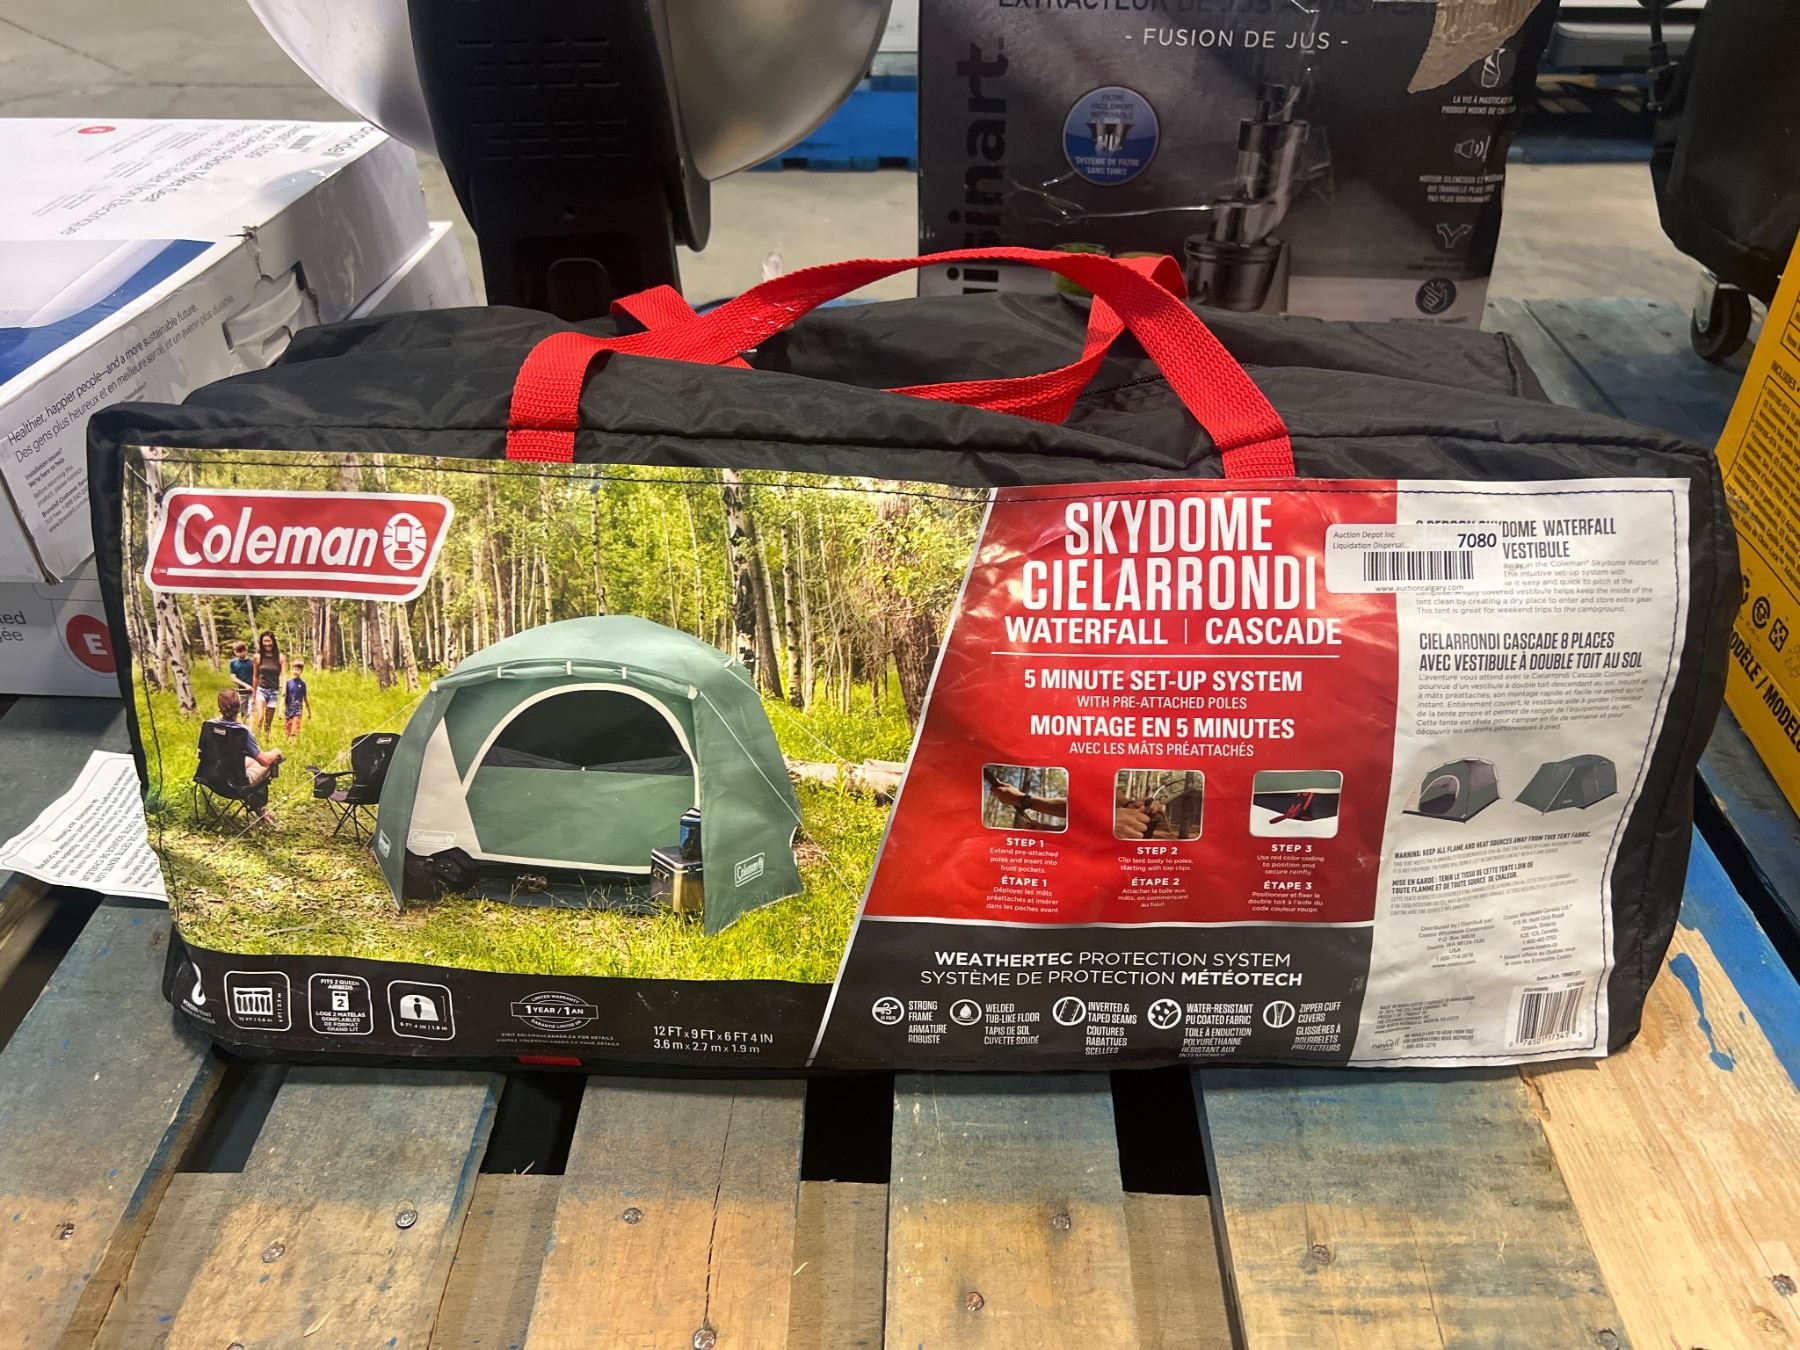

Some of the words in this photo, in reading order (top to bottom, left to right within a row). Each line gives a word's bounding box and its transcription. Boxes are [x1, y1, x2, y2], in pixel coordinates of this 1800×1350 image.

[1143, 28, 1234, 48] FUSION
[1244, 30, 1276, 48] DE
[1286, 32, 1330, 50] JUS
[8, 414, 47, 446] Healthier,
[45, 391, 76, 418] happier
[126, 343, 144, 360] more
[143, 317, 178, 347] sustainable
[177, 304, 198, 322] future.
[1770, 358, 1798, 392] INCLUDES
[16, 446, 33, 462] Des
[33, 430, 54, 452] gens
[52, 417, 70, 438] plus
[68, 395, 100, 422] heureux
[100, 388, 108, 400] et
[108, 382, 118, 394] en
[117, 360, 147, 386] meilleure
[165, 338, 174, 350] et
[172, 333, 182, 344] un
[182, 320, 200, 338] avenir
[200, 310, 213, 328] plus
[1064, 497, 1273, 555] SKYDOME
[1543, 518, 1616, 536] WATERFALL
[174, 504, 378, 567] Coleman
[1363, 532, 1383, 540] Depot
[1457, 533, 1497, 548] 7080
[1333, 542, 1371, 550] Liquidation
[1503, 541, 1570, 559] VESTIBULE
[1022, 555, 1316, 611] CIELARRONDI
[1375, 584, 1464, 592] www.auctioncalgary.com
[1005, 617, 1168, 645] WATERFALL
[1205, 618, 1342, 645] CASCADE
[82, 633, 108, 655] E
[1419, 633, 1500, 650] CIELARRONDI
[1503, 633, 1558, 650] CASCADE
[1561, 633, 1568, 648] 8
[1571, 632, 1614, 648] PLACES
[1419, 654, 1451, 671] AVEC
[1454, 653, 1516, 671] VESTIBULE
[1519, 651, 1528, 670] À
[1529, 652, 1573, 670] DOUBLE
[1576, 652, 1601, 669] TOIT
[1603, 652, 1618, 669] AU
[1621, 652, 1642, 668] SOL
[1730, 632, 1761, 682] ODÈLE
[1024, 669, 1036, 689] 5
[1041, 670, 1124, 690] MINUTE
[1130, 670, 1207, 691] SET-UP
[1212, 671, 1302, 692] SYSTEM
[1077, 696, 1110, 708] WITH
[1112, 696, 1204, 709] PRE-ATTACHED
[1208, 697, 1247, 710] POLES
[1030, 715, 1136, 738] MONTAGE
[1142, 717, 1170, 738] EN
[1177, 718, 1188, 738] 5
[1194, 718, 1295, 739] MINUTES
[1069, 742, 1101, 754] AVEC
[1103, 742, 1125, 755] LES
[1128, 739, 1164, 756] MÂTS
[1166, 741, 1254, 757] PRÉATTACHÉS
[1006, 838, 1036, 847] STEP
[1040, 839, 1044, 847] 1
[1272, 844, 1301, 852] STEP
[1015, 849, 1058, 857] pre-attached
[1137, 847, 1167, 855] STEP
[1171, 847, 1178, 855] 2
[1001, 875, 1038, 887] ÉTAPE
[1042, 879, 1047, 887] 1
[1132, 877, 1168, 886] ÉTAPE
[1264, 881, 1301, 889] ÉTAPE
[934, 952, 1073, 967] WEATHERTEC
[1078, 952, 1206, 966] PROTECTION
[1212, 952, 1290, 967] SYSTEM
[920, 969, 1010, 986] SYSTÈME
[1016, 972, 1042, 985] DE
[1048, 970, 1175, 985] PROTECTION
[1181, 968, 1302, 986] MÉTÉOTECH
[526, 1005, 531, 1013] 1
[564, 1007, 570, 1015] 1
[908, 1001, 937, 1010] STRONG
[986, 1003, 1014, 1013] WELDED
[1088, 1002, 1122, 1013] INVERTED
[1123, 1002, 1129, 1012] &
[1186, 1003, 1253, 1014] WATER-RESISTANT
[1300, 1002, 1322, 1013] ZIPPER
[1324, 1002, 1341, 1011] CUFF
[908, 1012, 933, 1021] FRAME
[985, 1014, 1016, 1024] TUB-LIKE
[1018, 1013, 1040, 1022] FLOOR
[1088, 1012, 1110, 1024] TAPED
[1112, 1014, 1137, 1025] SEAMS
[1185, 1014, 1197, 1024] PU
[1198, 1015, 1225, 1025] COATED
[1226, 1015, 1251, 1025] FABRIC
[1298, 1013, 1325, 1023] COVERS
[653, 1026, 666, 1036] 12
[668, 1026, 682, 1037] FT
[692, 1028, 698, 1039] 9
[701, 1029, 714, 1040] FT
[724, 1031, 731, 1041] 6
[734, 1032, 748, 1042] FT
[750, 1032, 757, 1042] 4
[760, 1033, 773, 1044] IN
[908, 1024, 947, 1034] ARMATURE
[985, 1026, 1005, 1035] TAPIS
[1006, 1026, 1015, 1035] DE
[1017, 1026, 1030, 1035] SOL
[908, 1035, 940, 1044] ROBUSTE
[1372, 1038, 1400, 1050] newell
[653, 1039, 670, 1049] 3.6
[672, 1042, 683, 1050] m
[692, 1041, 708, 1052] 2.7
[711, 1044, 722, 1052] m
[731, 1044, 747, 1053] 1.9
[750, 1046, 760, 1054] m
